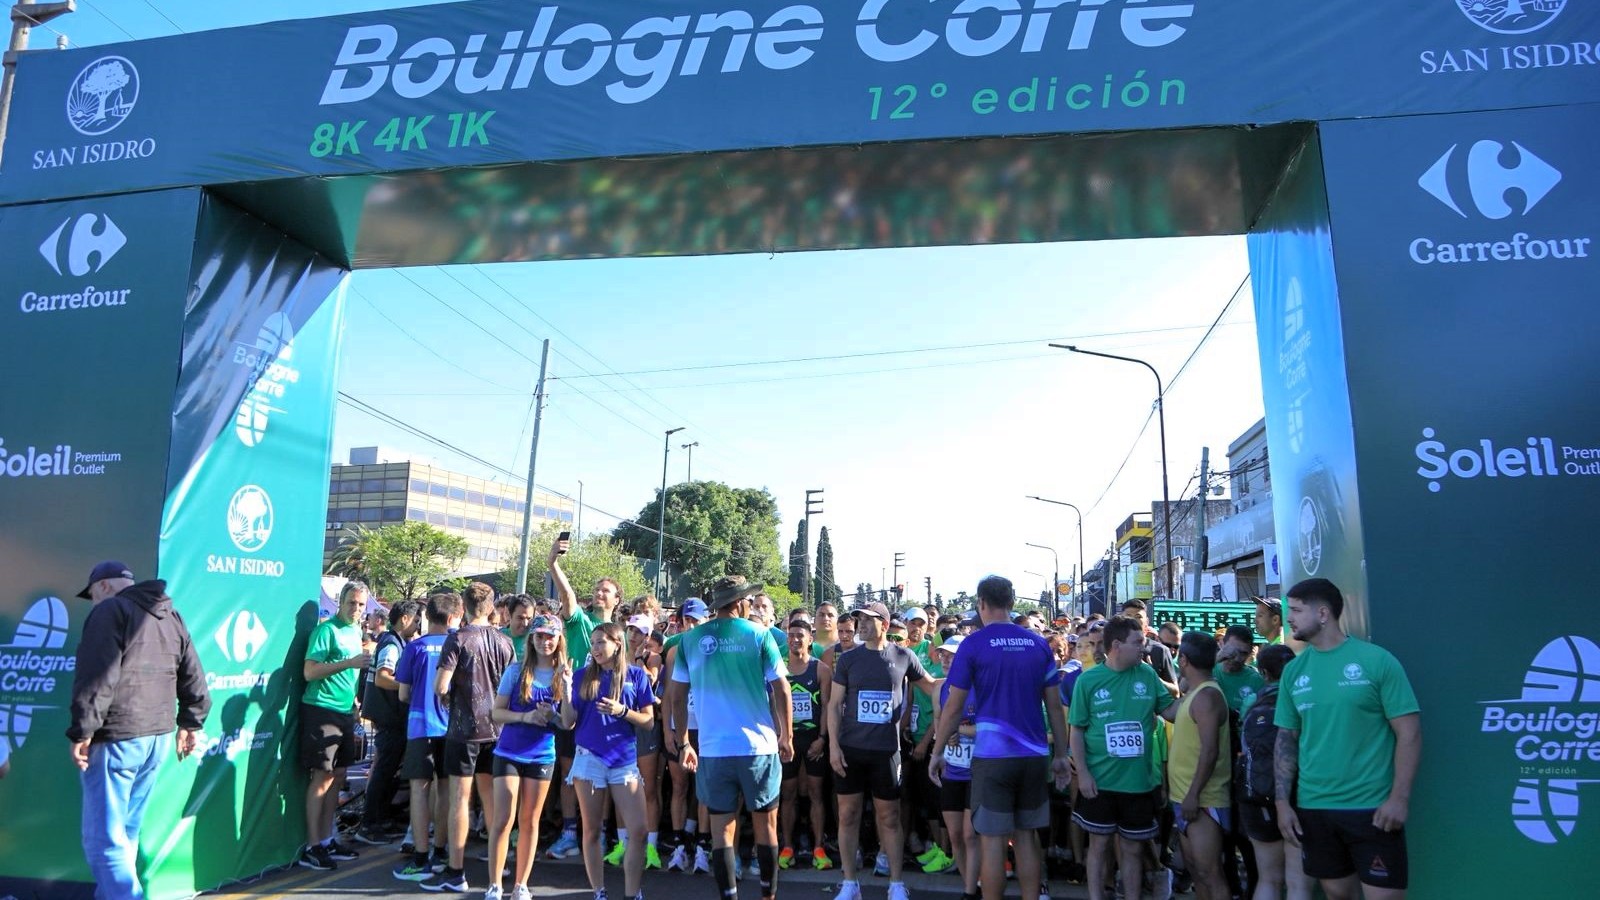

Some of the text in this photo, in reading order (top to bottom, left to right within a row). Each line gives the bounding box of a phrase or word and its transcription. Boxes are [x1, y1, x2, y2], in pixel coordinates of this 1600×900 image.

[319, 0, 1195, 105] Boulogne Corre
[1419, 42, 1600, 75] SAN ISIDR
[867, 70, 1188, 121] 12° edición
[309, 110, 496, 158] 8K 4K 1K
[32, 138, 156, 170] SAN ISIDRO
[1409, 232, 1590, 265] Carrefour
[20, 286, 131, 313] Carrefour
[73, 464, 105, 475] Outlet
[75, 451, 121, 463] Premium
[1415, 427, 1559, 493] Soleil
[207, 555, 284, 578] SAN ISIDRO
[990, 638, 1035, 647] SAN ISIDRO
[0, 650, 76, 675] oulogne
[1, 672, 56, 693] Corre
[861, 701, 889, 715] 902
[1480, 706, 1600, 739] Boulog
[947, 745, 971, 759] 901
[1110, 735, 1142, 748] 5368
[1515, 735, 1600, 761] Corre
[1538, 766, 1577, 775] edición
